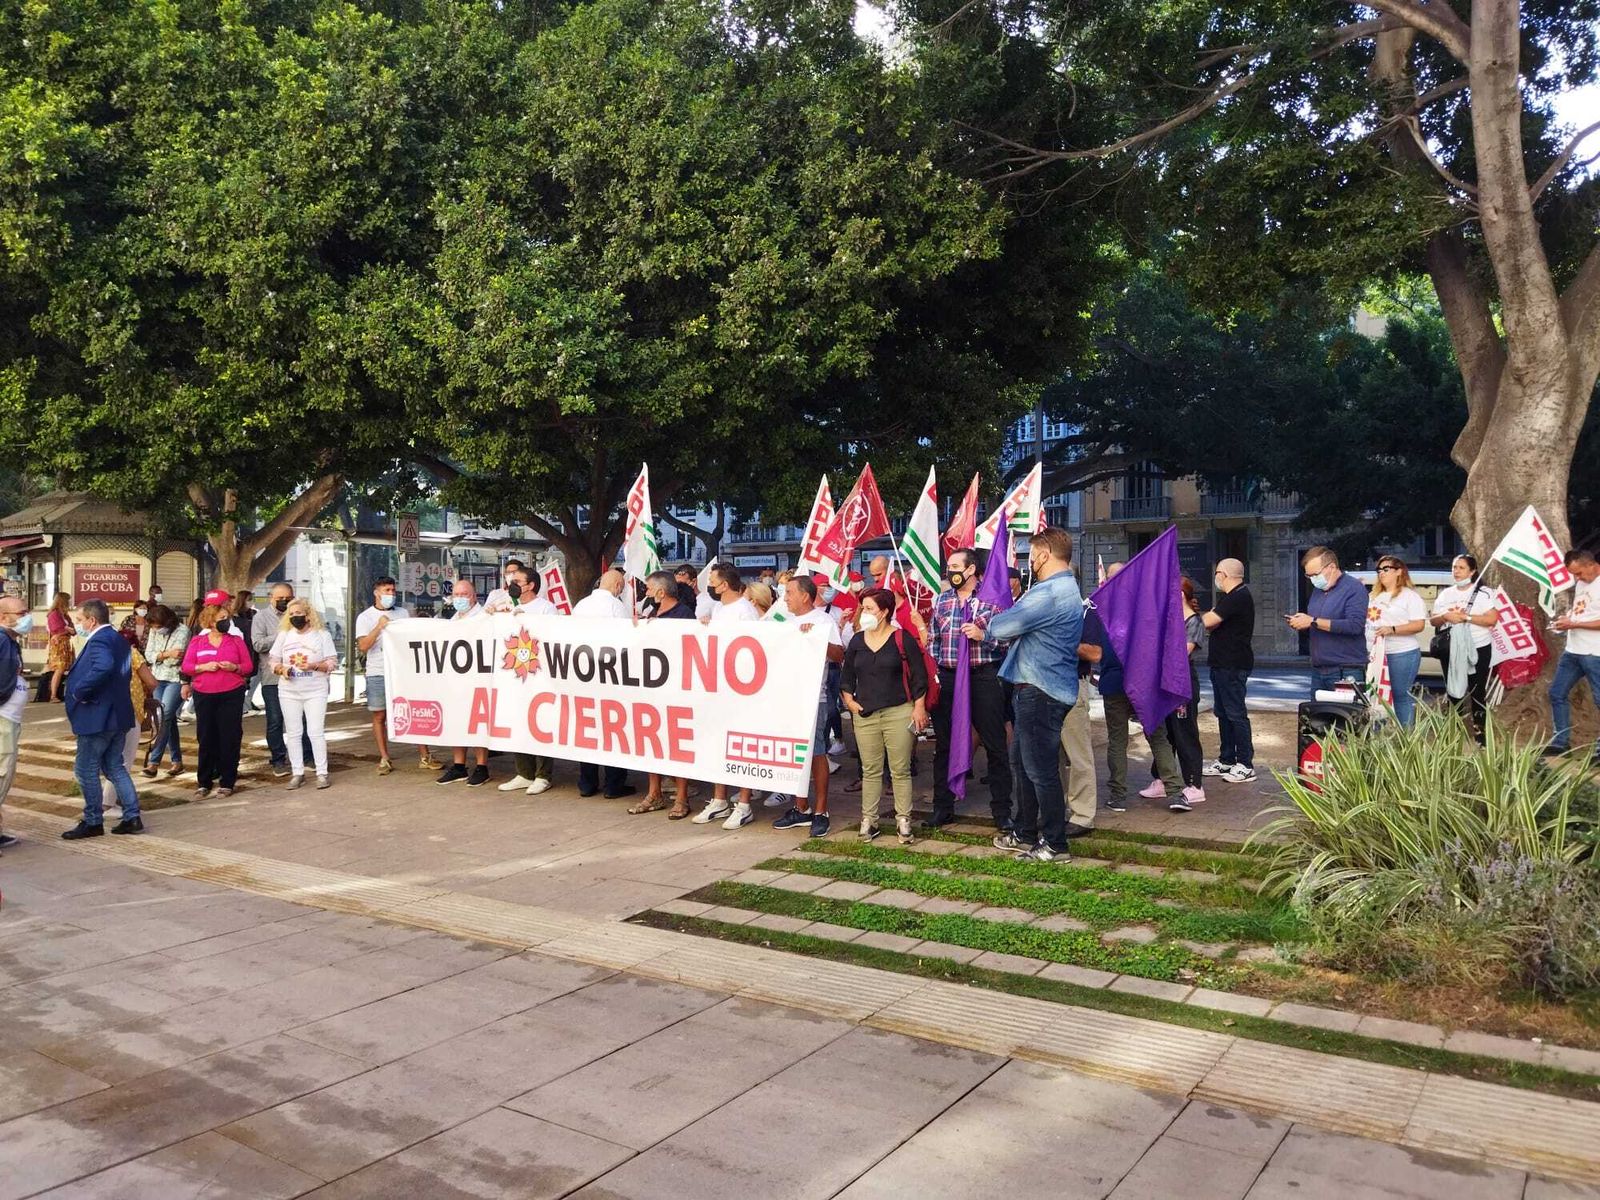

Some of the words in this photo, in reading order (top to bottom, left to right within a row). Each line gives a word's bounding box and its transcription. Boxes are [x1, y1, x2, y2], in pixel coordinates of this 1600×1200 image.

[83, 573, 129, 581] CIGARROS
[429, 566, 439, 575] 14
[444, 567, 453, 577] 19
[80, 583, 98, 592] DE
[100, 583, 134, 592] CUBA
[431, 583, 437, 594] E
[544, 642, 669, 688] WORLD
[682, 634, 768, 696] NO
[412, 707, 437, 718] FeSMC
[468, 687, 511, 739] AL
[527, 691, 695, 764] CIERRE
[726, 762, 773, 779] servicios
